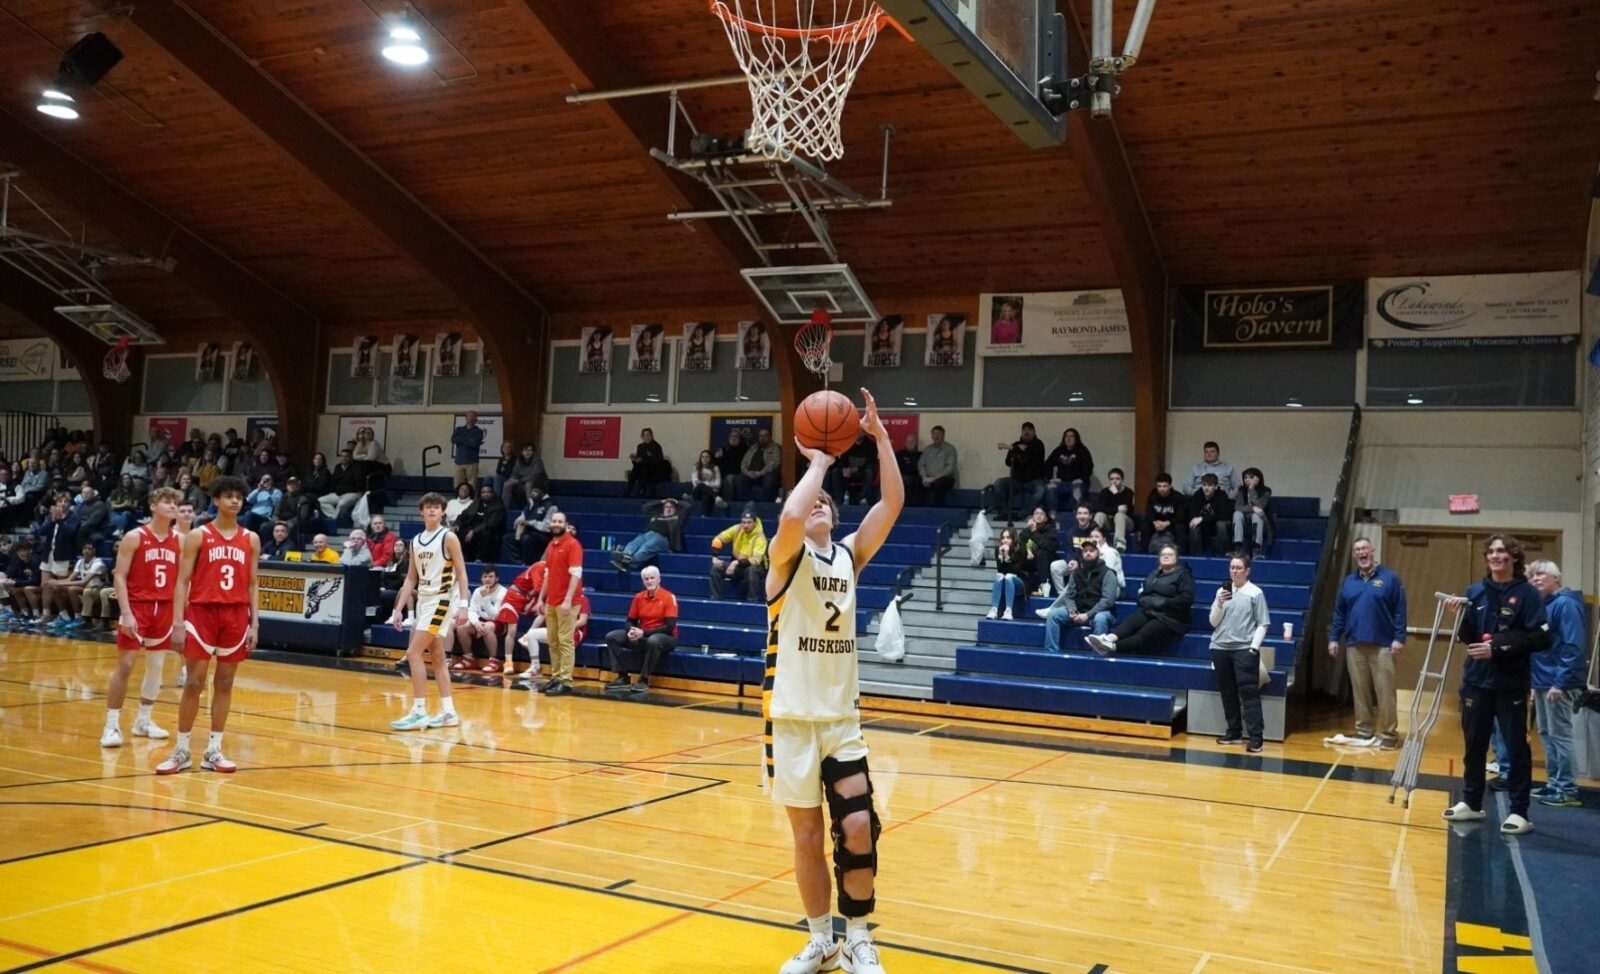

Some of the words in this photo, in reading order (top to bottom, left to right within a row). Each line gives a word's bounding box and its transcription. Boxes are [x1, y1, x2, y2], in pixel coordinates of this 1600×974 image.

[1213, 294, 1294, 316] Hobo's
[1051, 325, 1097, 335] RAYMOND
[1097, 324, 1128, 333] JAMES
[1235, 314, 1323, 341] Tavern
[1387, 339, 1420, 348] Proudly
[1423, 338, 1471, 349] Supporting
[868, 352, 898, 366] NORSE
[929, 351, 961, 365] NORSE
[145, 547, 176, 565] HOLTON
[208, 545, 245, 565] HOLTON
[154, 563, 167, 588] 5
[219, 563, 235, 591] 3
[812, 576, 848, 593] NORTH
[824, 601, 841, 632] 2
